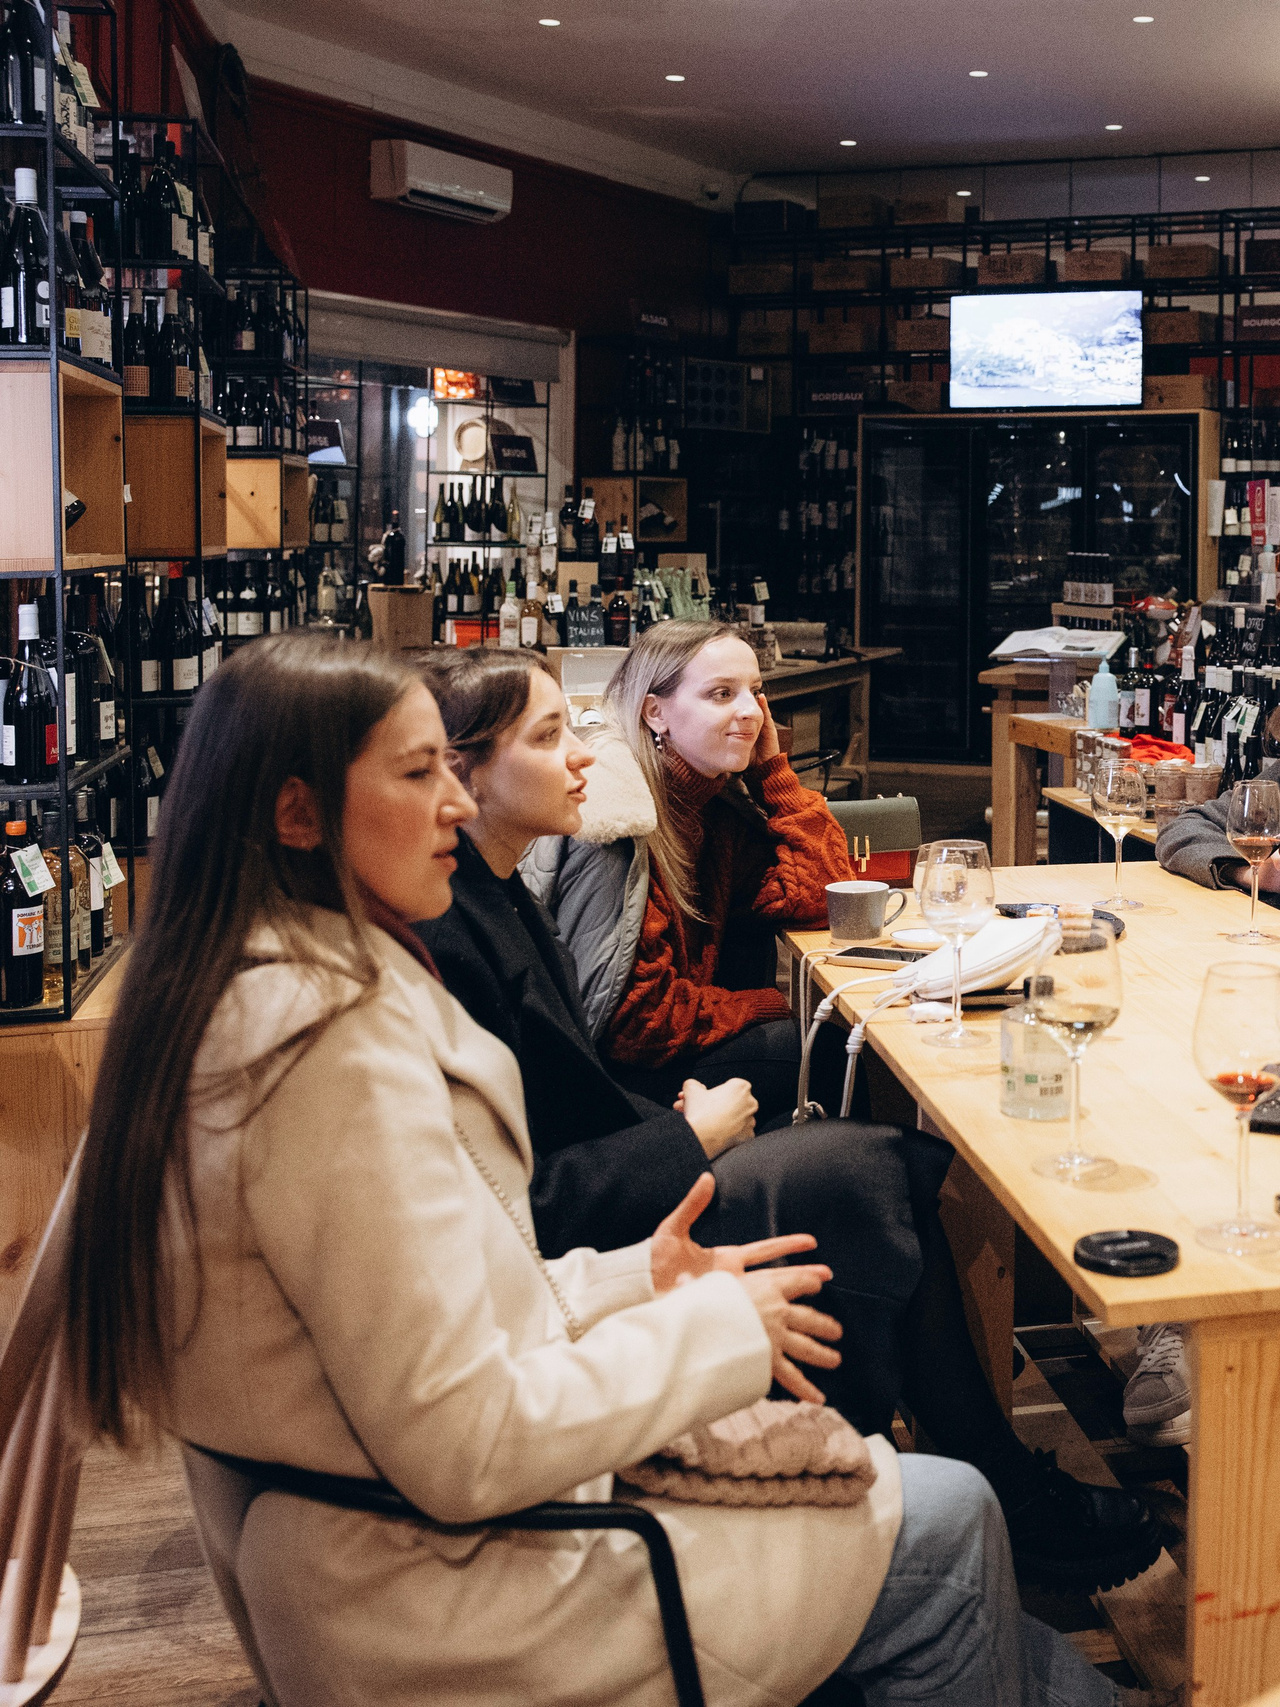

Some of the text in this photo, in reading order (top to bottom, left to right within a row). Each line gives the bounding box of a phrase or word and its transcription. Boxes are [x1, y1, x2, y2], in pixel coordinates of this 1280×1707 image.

[811, 392, 864, 401] BORDEAUX
[568, 609, 600, 622] VINS
[1241, 641, 1257, 651] MOIS
